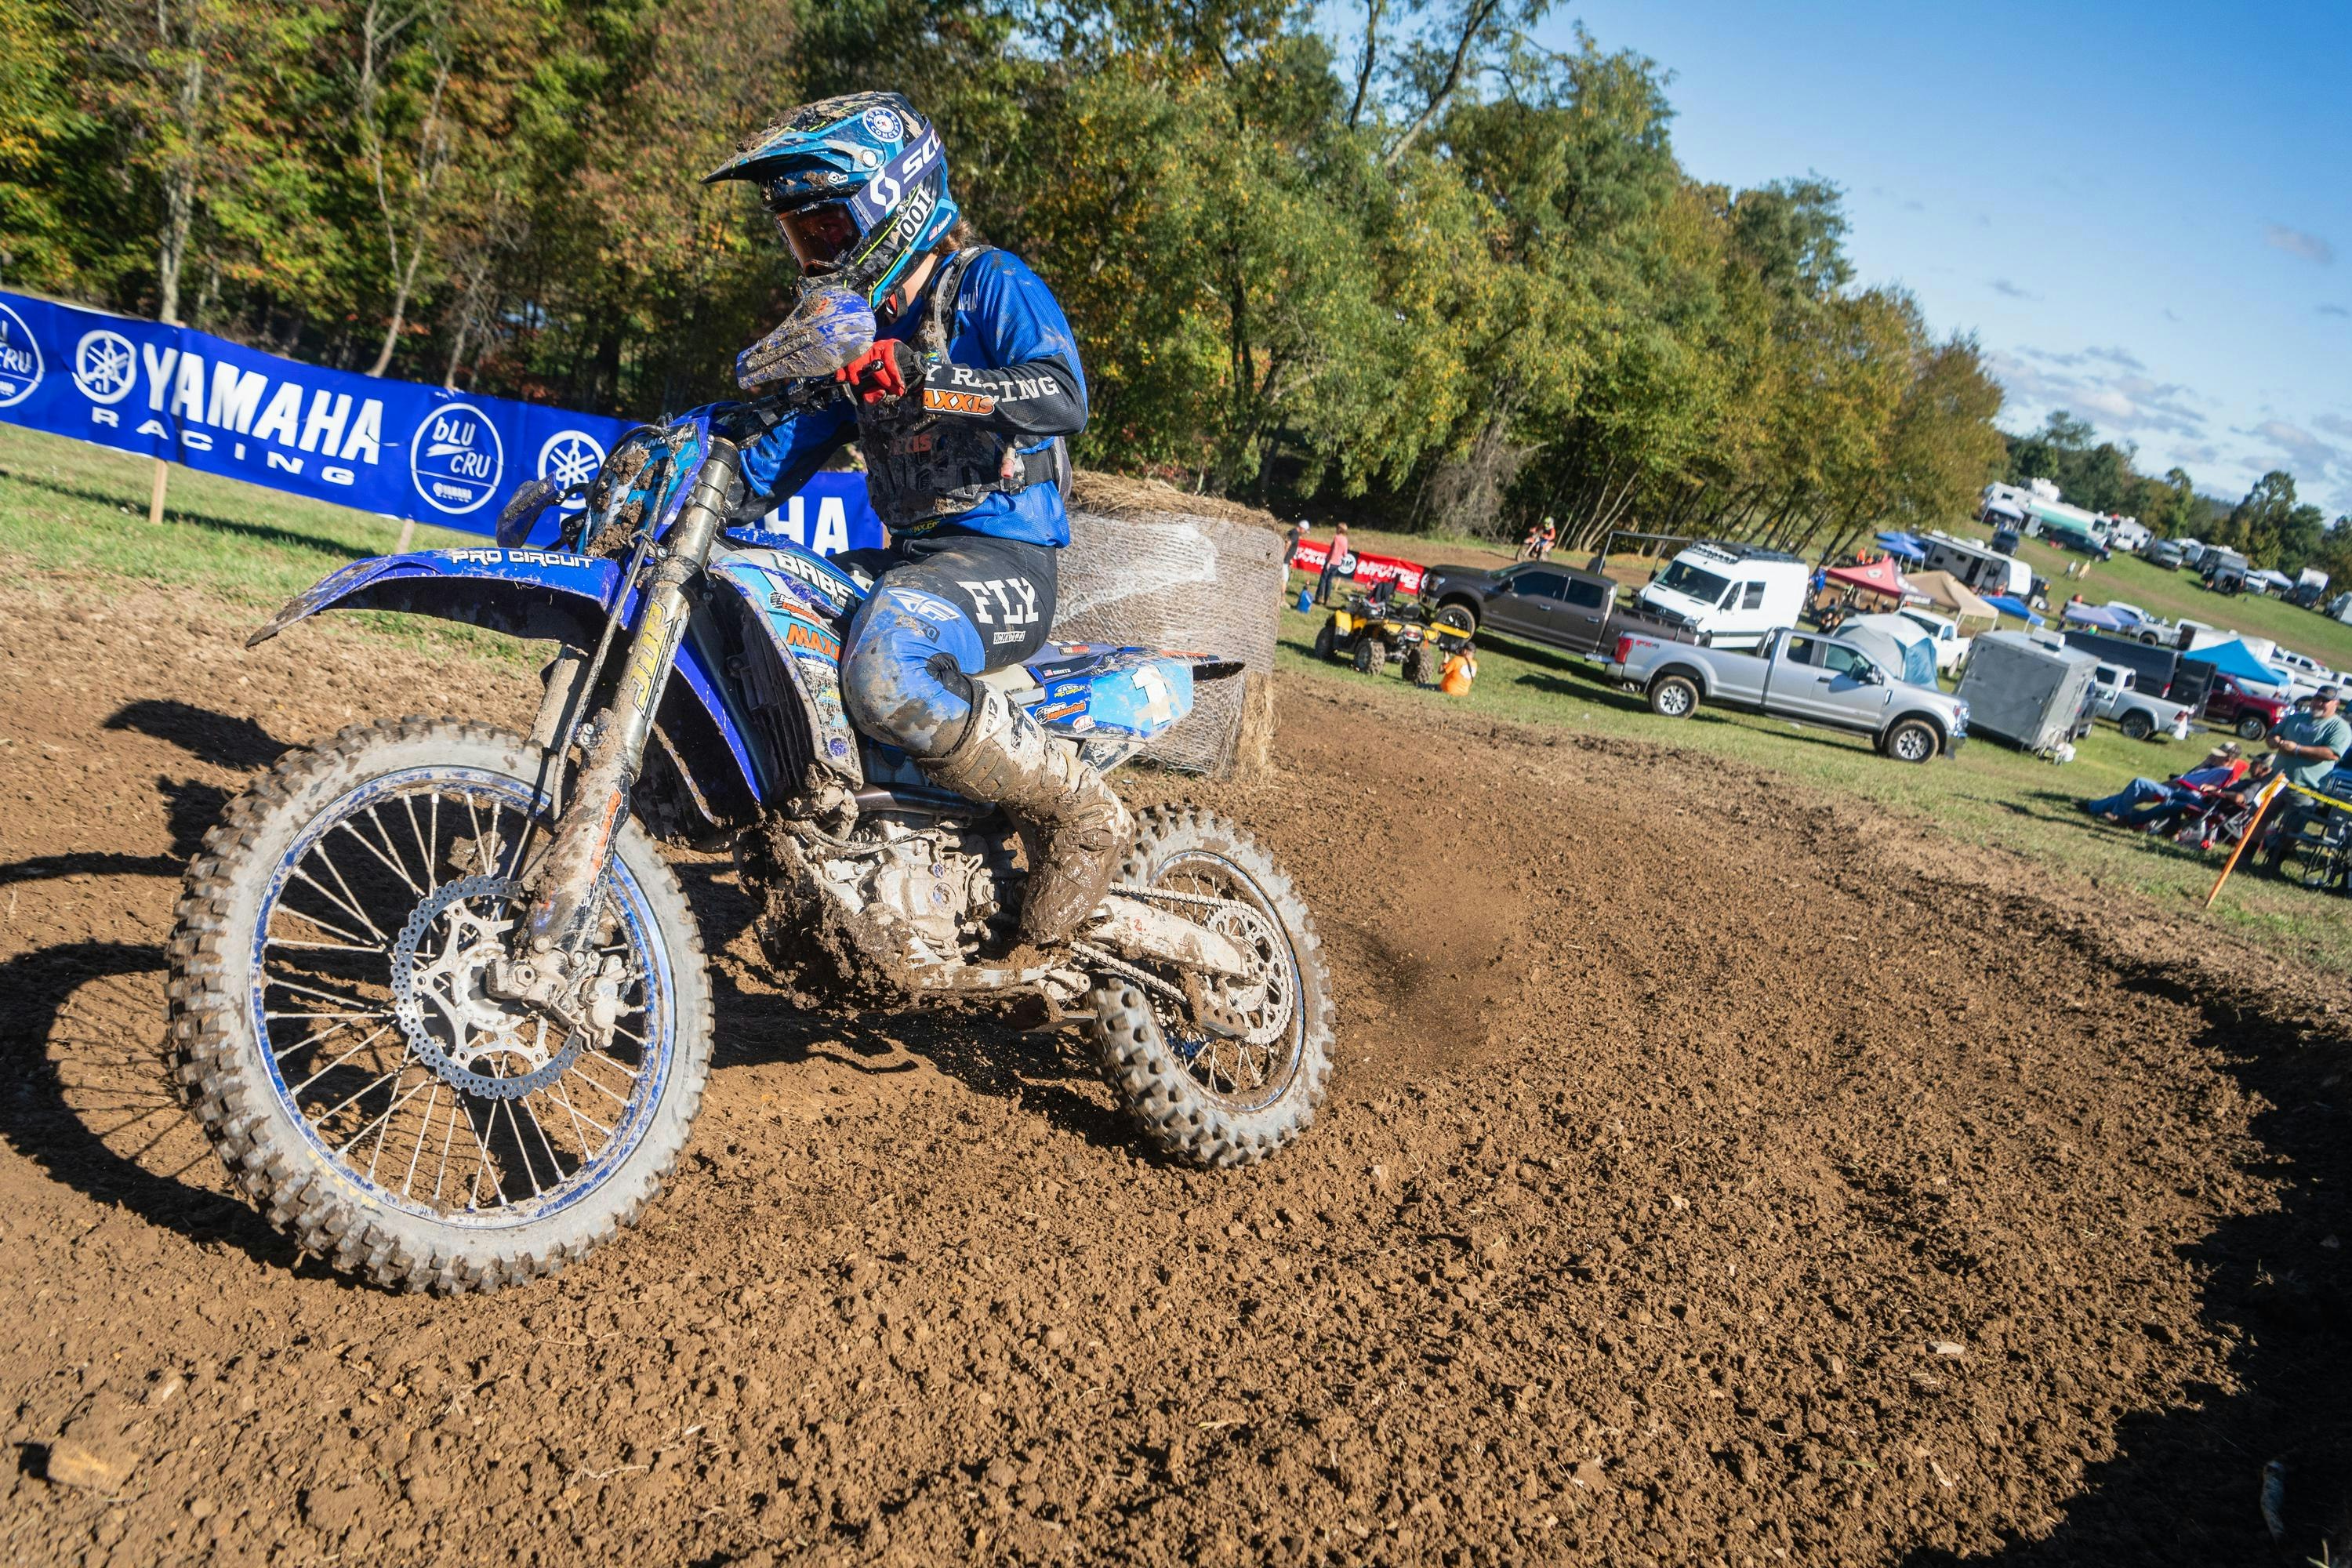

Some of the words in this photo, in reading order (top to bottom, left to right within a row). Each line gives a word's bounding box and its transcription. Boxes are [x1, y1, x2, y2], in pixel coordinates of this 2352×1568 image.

[900, 193, 932, 238] 001
[0, 347, 32, 374] RU
[142, 342, 383, 465] YAMAHA
[924, 389, 993, 415] AXXIS
[91, 405, 355, 486] RACING
[452, 550, 503, 565] PRO
[509, 550, 593, 568] CIRCUIT
[772, 550, 857, 608] BABS
[955, 576, 1039, 624] FLY
[786, 622, 841, 662] MAXX
[1044, 703, 1066, 715] Enduro
[1047, 702, 1086, 720] Engineering
[1131, 666, 1172, 727] 1
